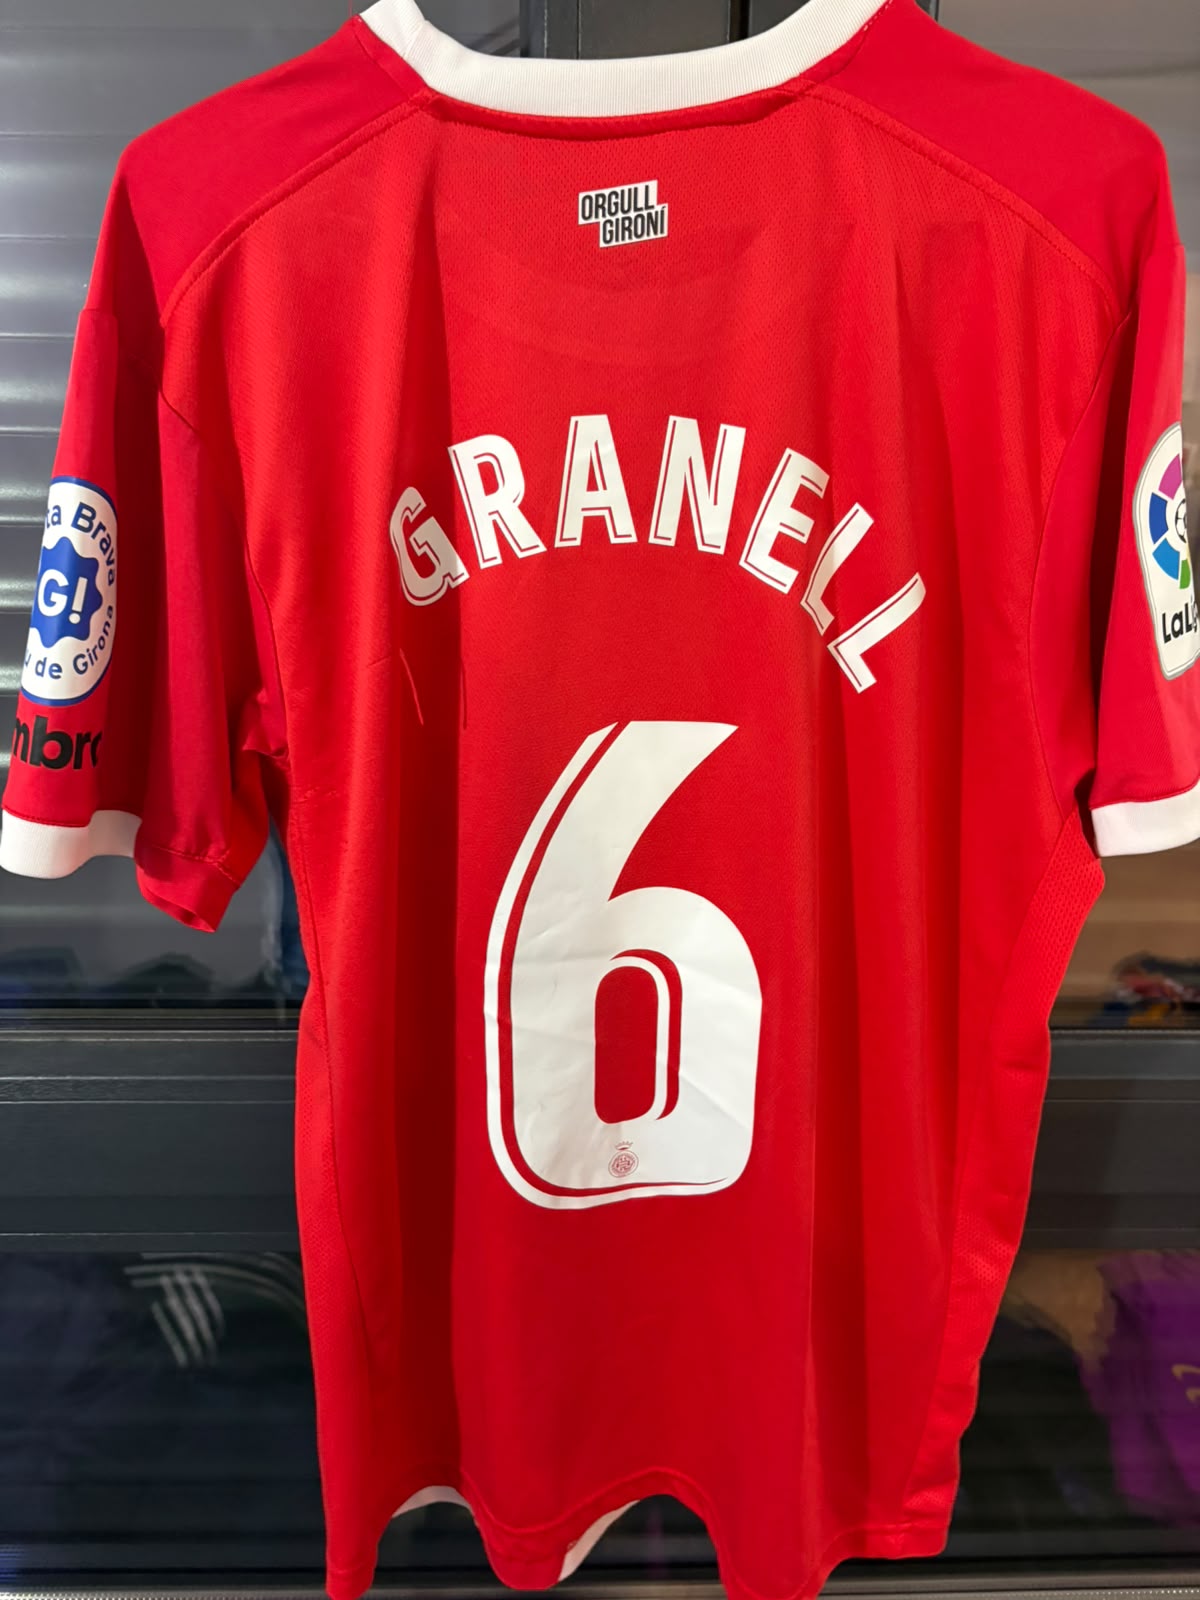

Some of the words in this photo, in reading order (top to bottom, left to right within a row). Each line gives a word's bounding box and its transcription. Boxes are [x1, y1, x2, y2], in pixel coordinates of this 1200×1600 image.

[581, 184, 655, 221] ORGULL
[602, 205, 666, 244] GIRONÍ
[71, 501, 116, 587] Brava
[389, 414, 927, 694] GRANELL
[35, 656, 63, 680] de
[73, 605, 114, 676] Girona
[484, 720, 763, 1211] 6
